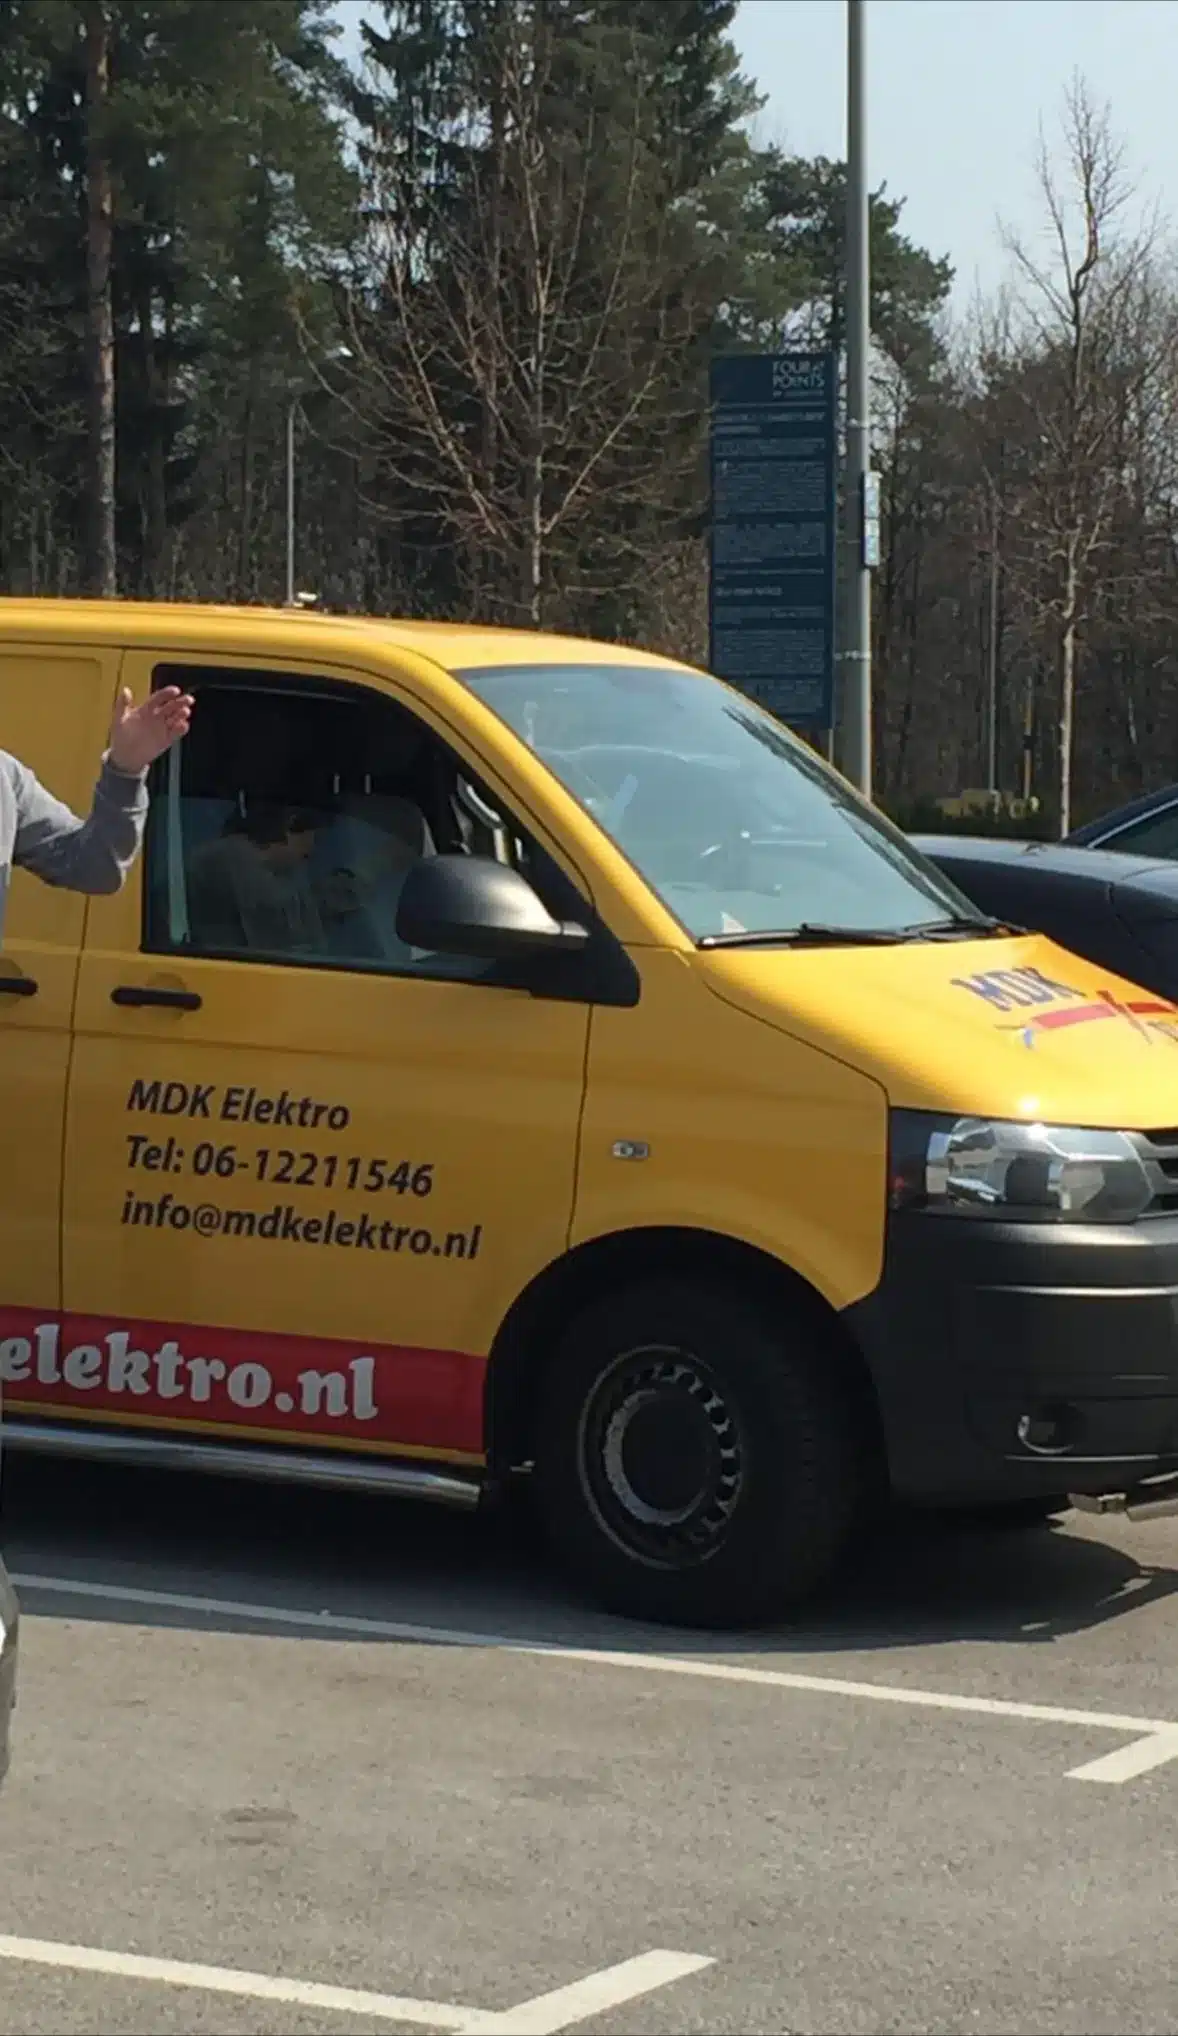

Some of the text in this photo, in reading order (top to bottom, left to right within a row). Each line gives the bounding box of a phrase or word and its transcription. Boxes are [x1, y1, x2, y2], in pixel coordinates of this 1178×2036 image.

[772, 360, 811, 374] FOUR
[772, 375, 825, 389] POINTS
[126, 1079, 350, 1131] MDK Elektro
[126, 1135, 435, 1198] Tel: 06-12211546
[121, 1190, 483, 1260] info@mdkelektro.nl
[0, 1323, 379, 1420] elektro.nl
